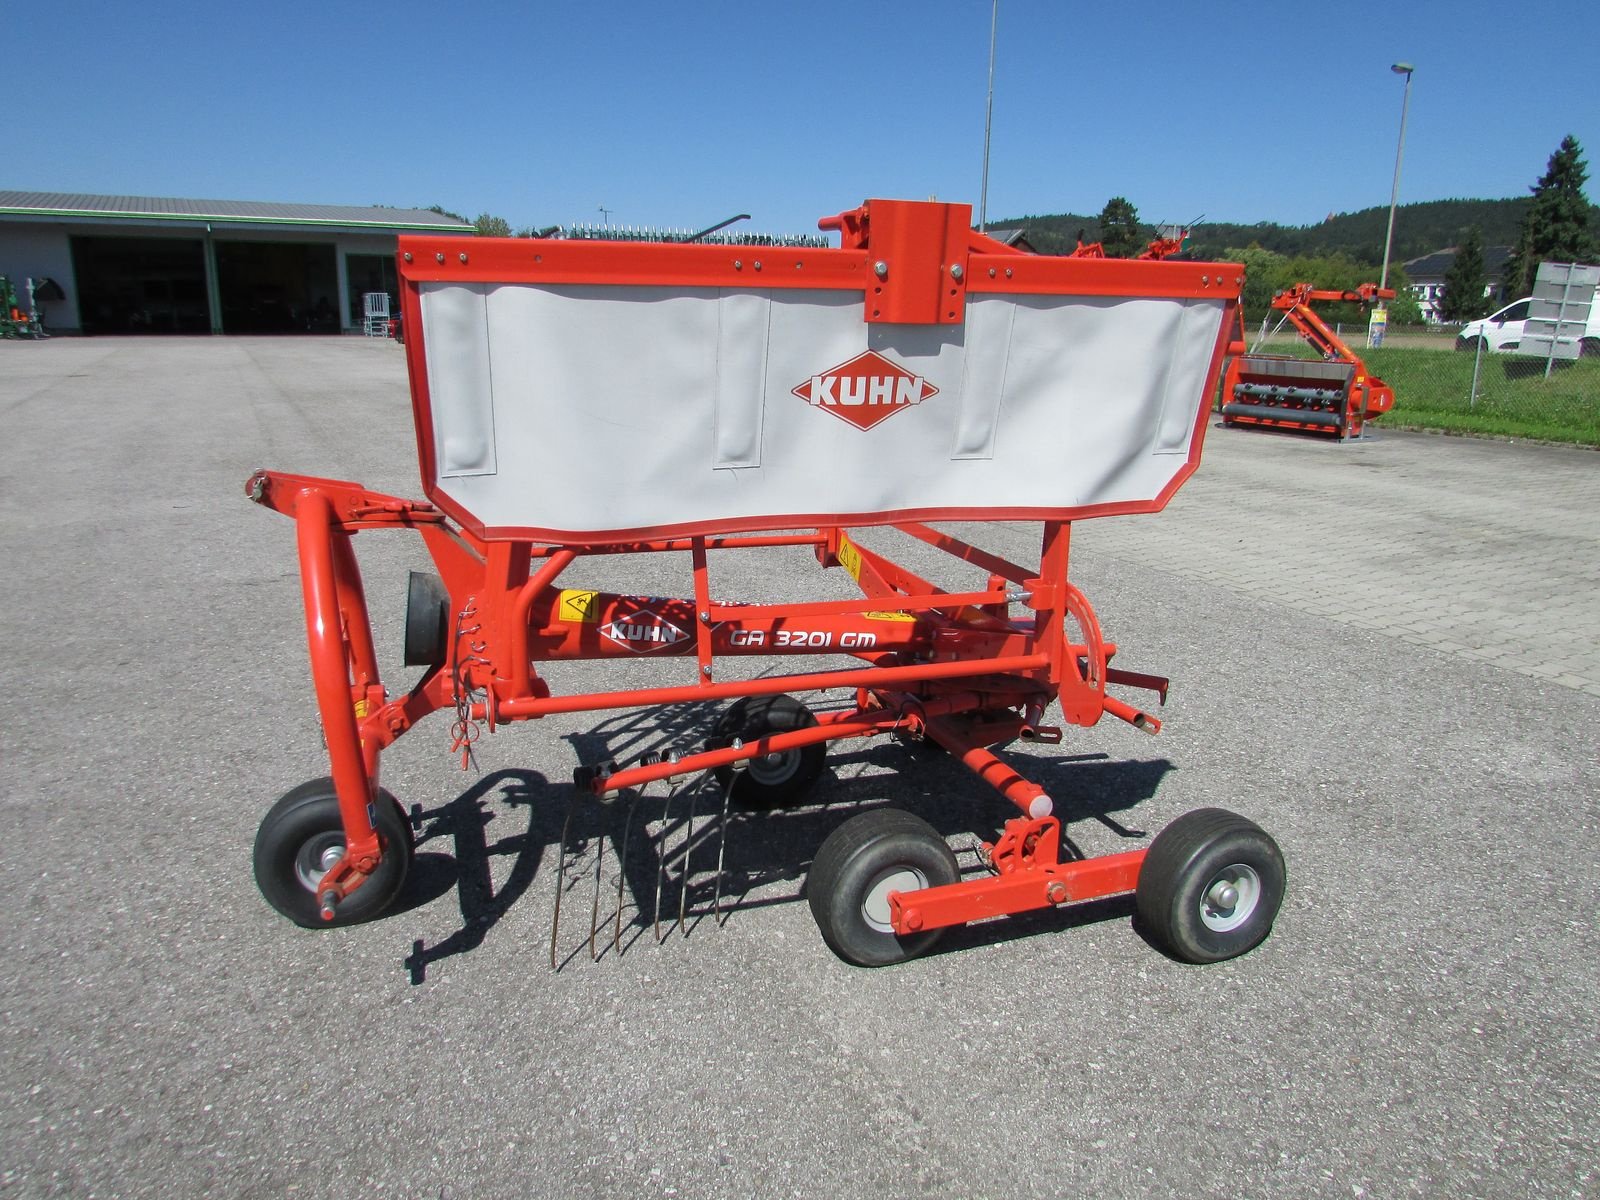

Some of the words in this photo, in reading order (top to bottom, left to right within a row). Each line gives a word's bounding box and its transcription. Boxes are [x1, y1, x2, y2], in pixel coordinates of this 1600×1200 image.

[810, 376, 924, 405] KUHN
[610, 623, 677, 642] KUHN
[730, 630, 765, 646] GA
[773, 631, 832, 647] 3201
[839, 632, 876, 648] GM
